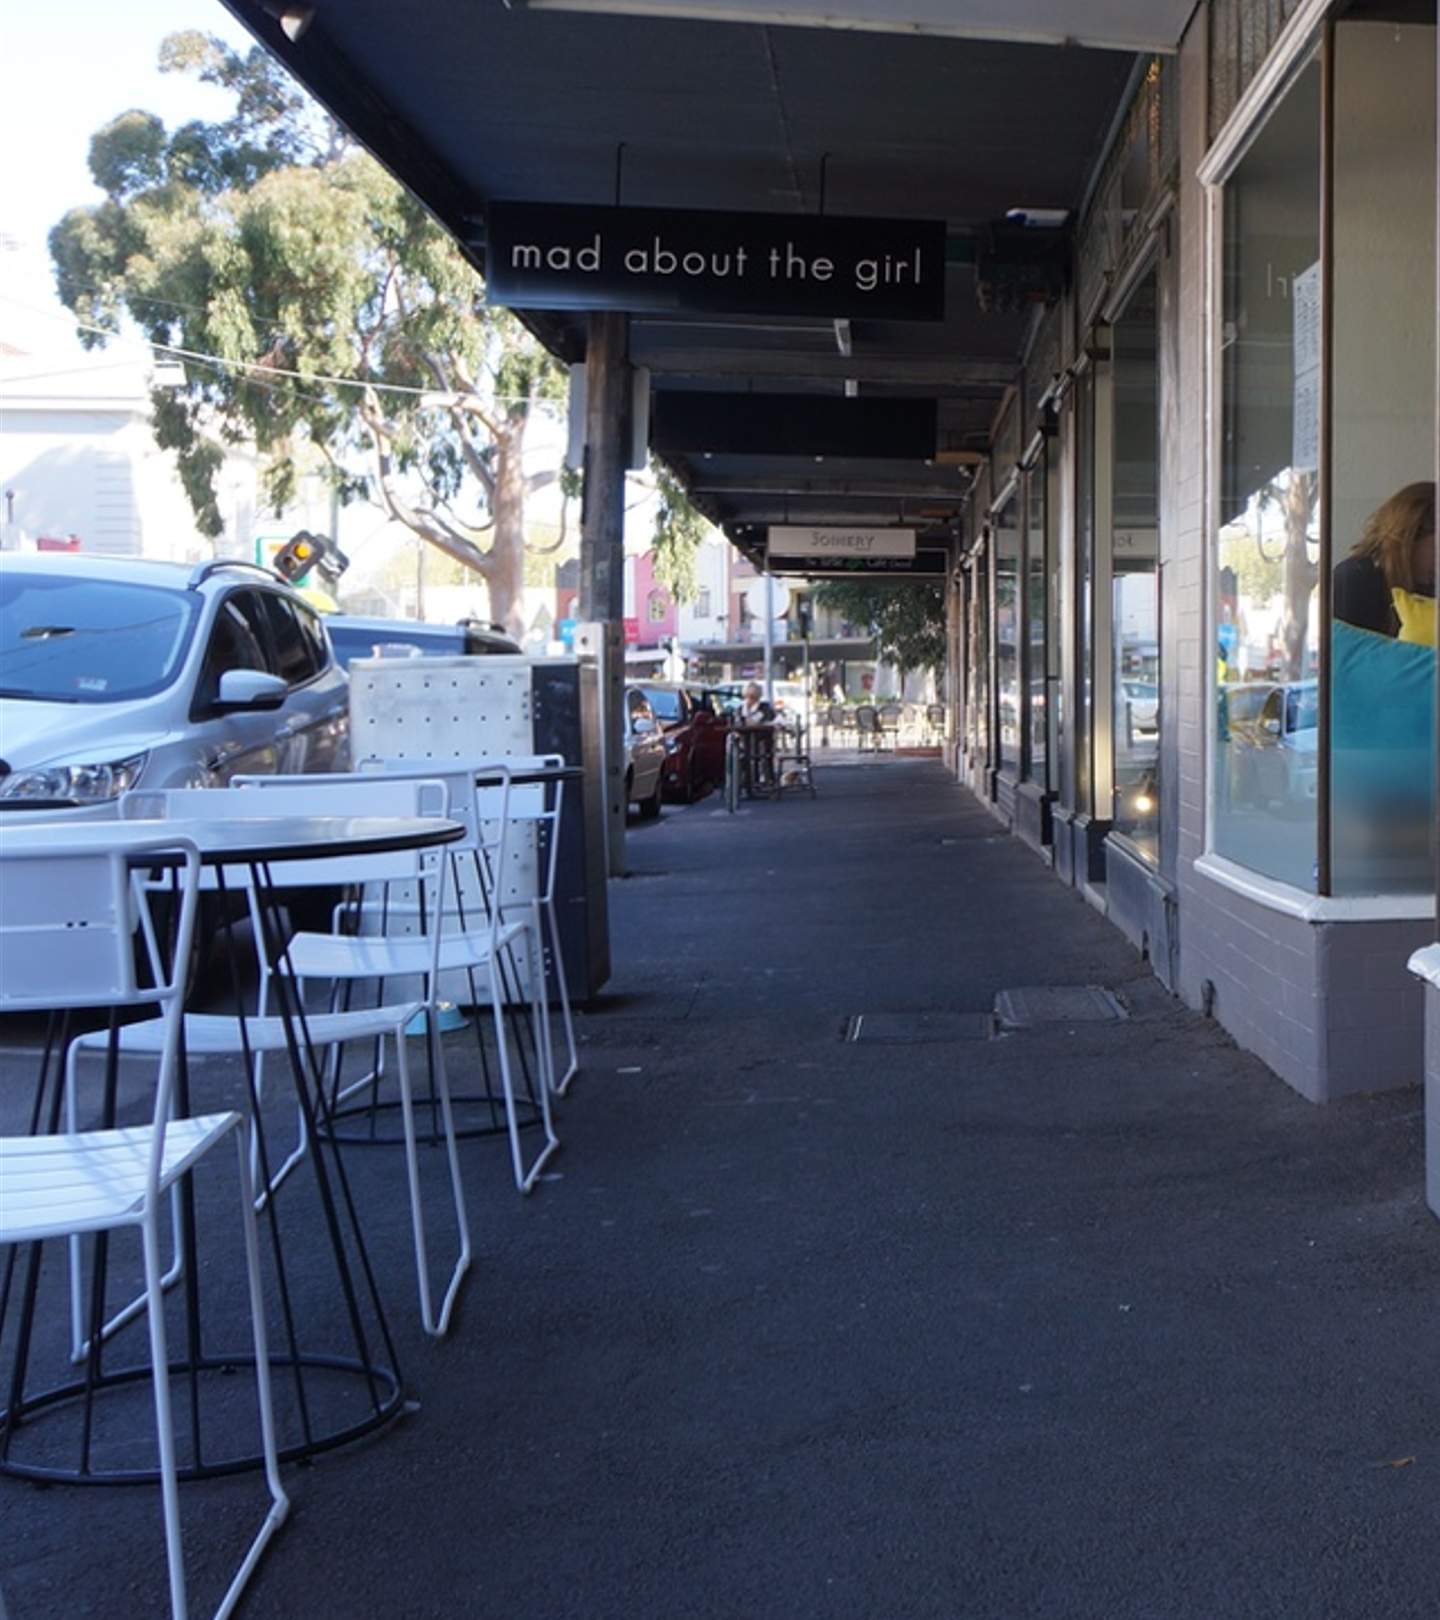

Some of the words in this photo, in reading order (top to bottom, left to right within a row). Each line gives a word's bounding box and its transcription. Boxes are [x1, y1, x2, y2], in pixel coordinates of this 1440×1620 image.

[511, 234, 601, 270] mad
[624, 236, 748, 277] about
[769, 242, 835, 281] the
[855, 247, 921, 290] girl
